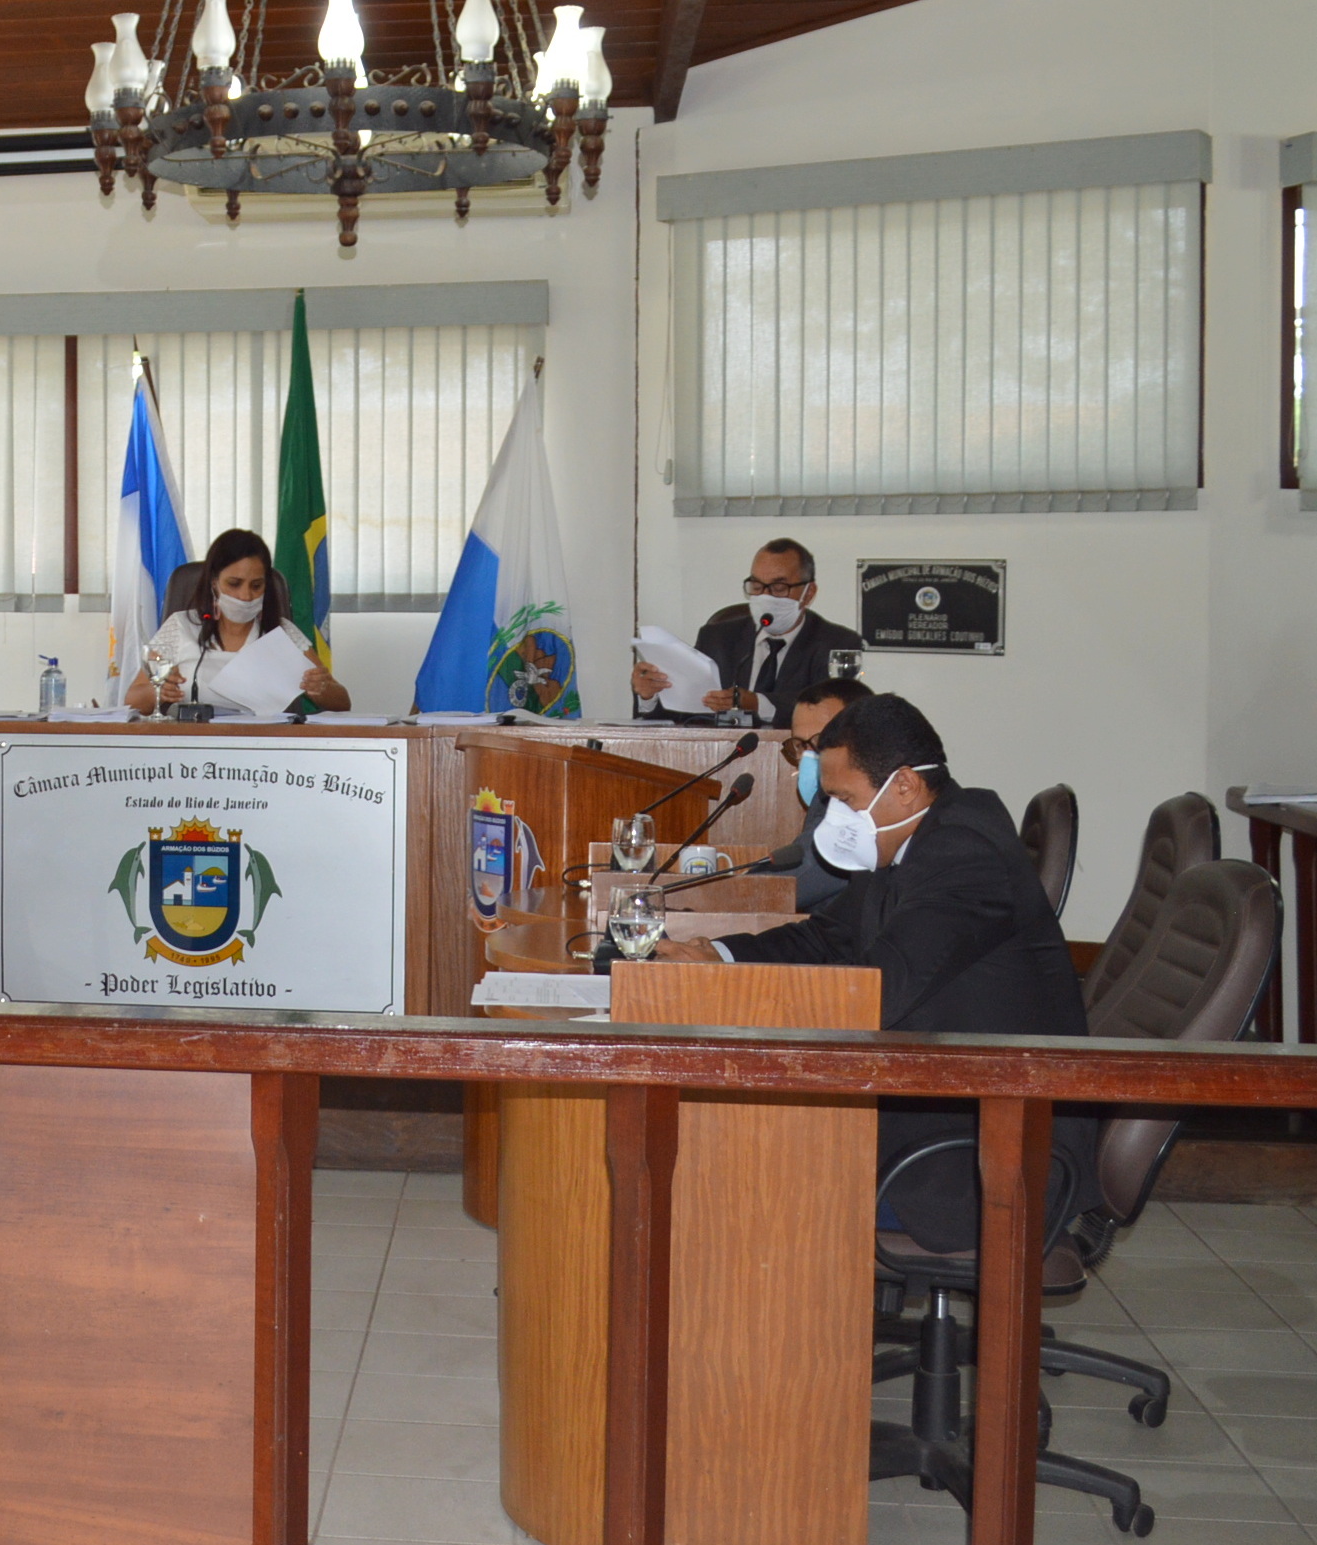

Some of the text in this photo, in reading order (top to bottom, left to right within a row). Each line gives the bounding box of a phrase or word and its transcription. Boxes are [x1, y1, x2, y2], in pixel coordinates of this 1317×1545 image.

[13, 761, 386, 805] Câmara Municipal de Armação dos Búzios
[125, 796, 164, 809] Estado
[167, 797, 181, 809] do
[223, 797, 268, 810] Janeiro
[161, 844, 192, 853] ARMAÇÃO
[207, 845, 230, 853] BÚZIOS
[100, 972, 159, 997] Poder
[166, 974, 277, 999] Legislativo
